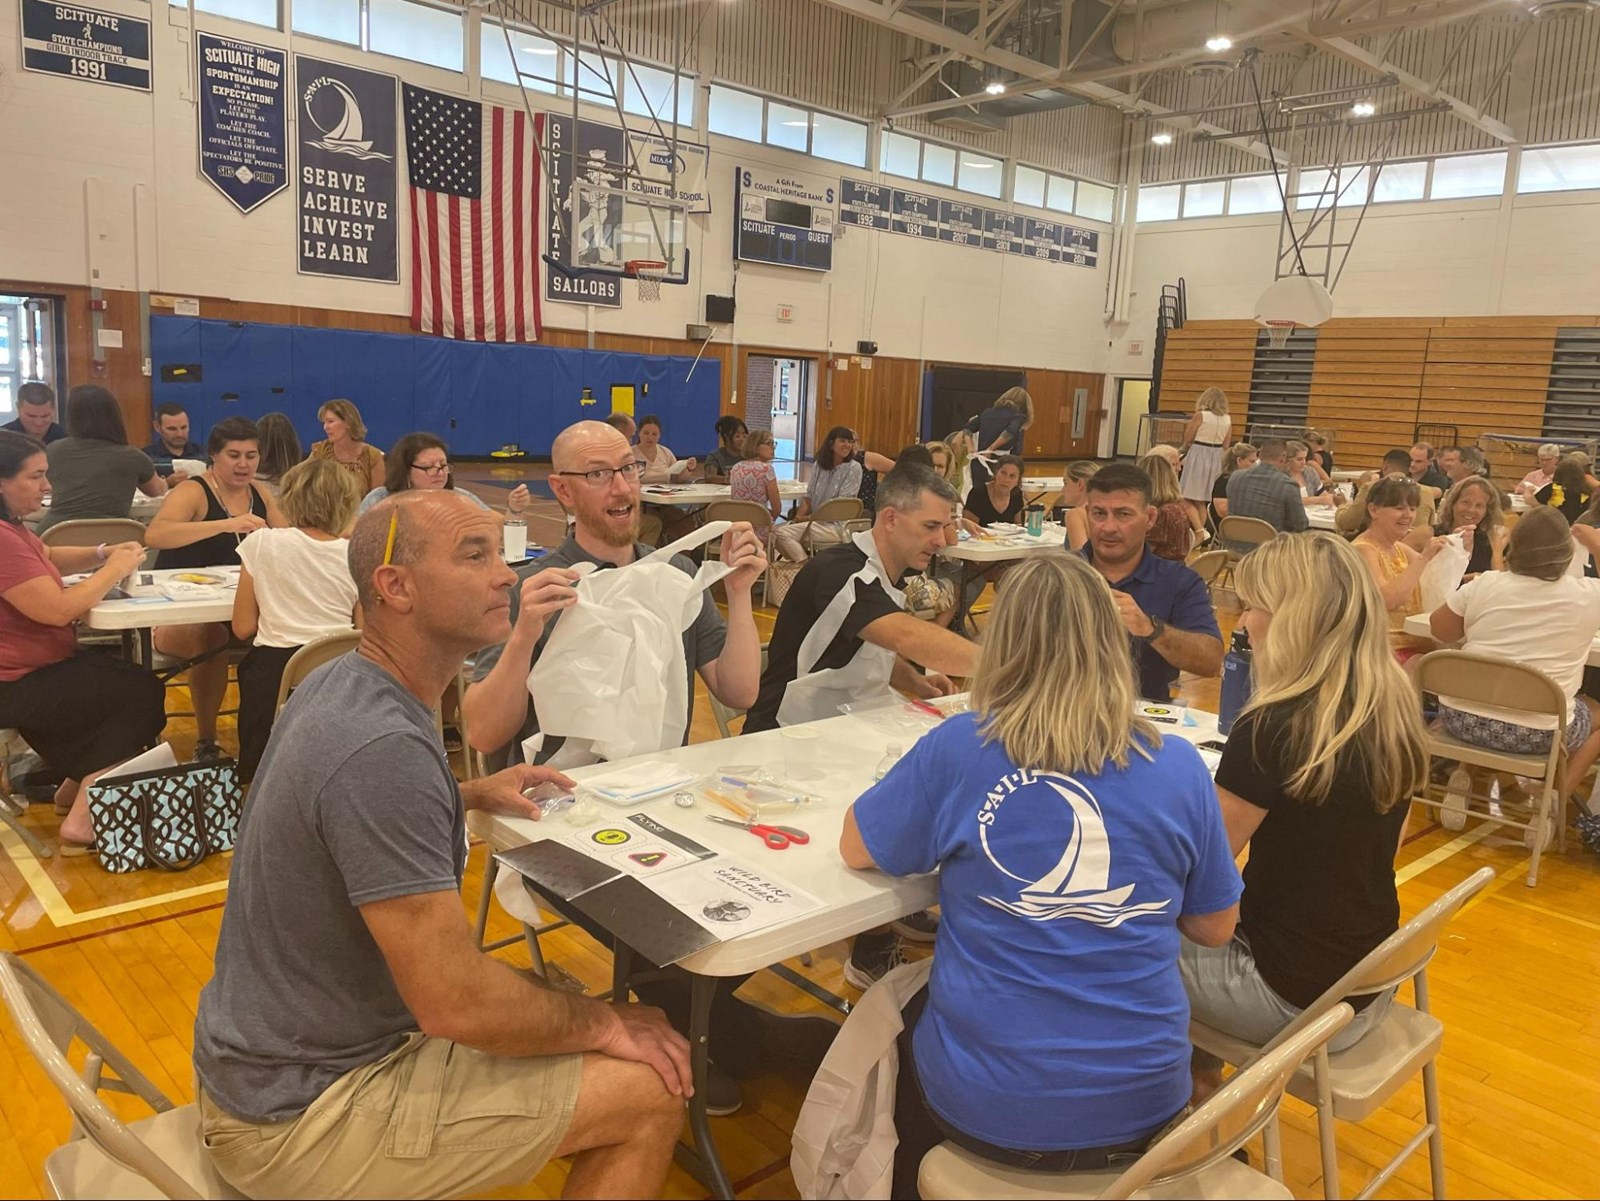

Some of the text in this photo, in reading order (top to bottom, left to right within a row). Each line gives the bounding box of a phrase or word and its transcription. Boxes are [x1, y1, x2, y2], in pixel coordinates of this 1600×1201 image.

[55, 7, 118, 31] SCITUATE
[52, 34, 122, 54] STATE CHAMPIONS
[221, 41, 254, 53] WELCOME
[47, 43, 128, 64] GIRLS INDOOR TRACK
[71, 58, 106, 80] 1991
[205, 48, 280, 77] SCITUATE HIGH
[232, 66, 254, 76] WHERE
[206, 68, 278, 90] SPORTSMANSHIP
[212, 85, 274, 105] EXPECTATION!
[220, 109, 248, 119] PLAYERS
[216, 123, 246, 134] COACHES
[208, 137, 242, 148] OFFICIALS
[203, 151, 243, 163] SPECTATORS
[219, 166, 274, 183] SHS PRIDE
[304, 167, 365, 193] SERVE
[743, 171, 751, 187] S
[679, 191, 704, 201] SCHOOL
[754, 182, 823, 201] COASTAL HERITAGE BANK
[826, 188, 834, 203] S
[855, 183, 879, 196] SCITUATE
[304, 192, 387, 219] ACHIEVE
[905, 194, 928, 206] SCITUATE
[857, 213, 873, 226] 1992
[304, 216, 375, 241] INVEST
[743, 221, 775, 235] SCITUATE
[808, 232, 829, 243] GUEST
[907, 223, 922, 235] 1994
[952, 232, 968, 243] 2007
[304, 240, 368, 264] LEARN
[553, 276, 615, 298] SAILORS
[635, 814, 665, 832] FLYING
[730, 866, 760, 882] WILD
[714, 869, 783, 904] SANCTUARY
